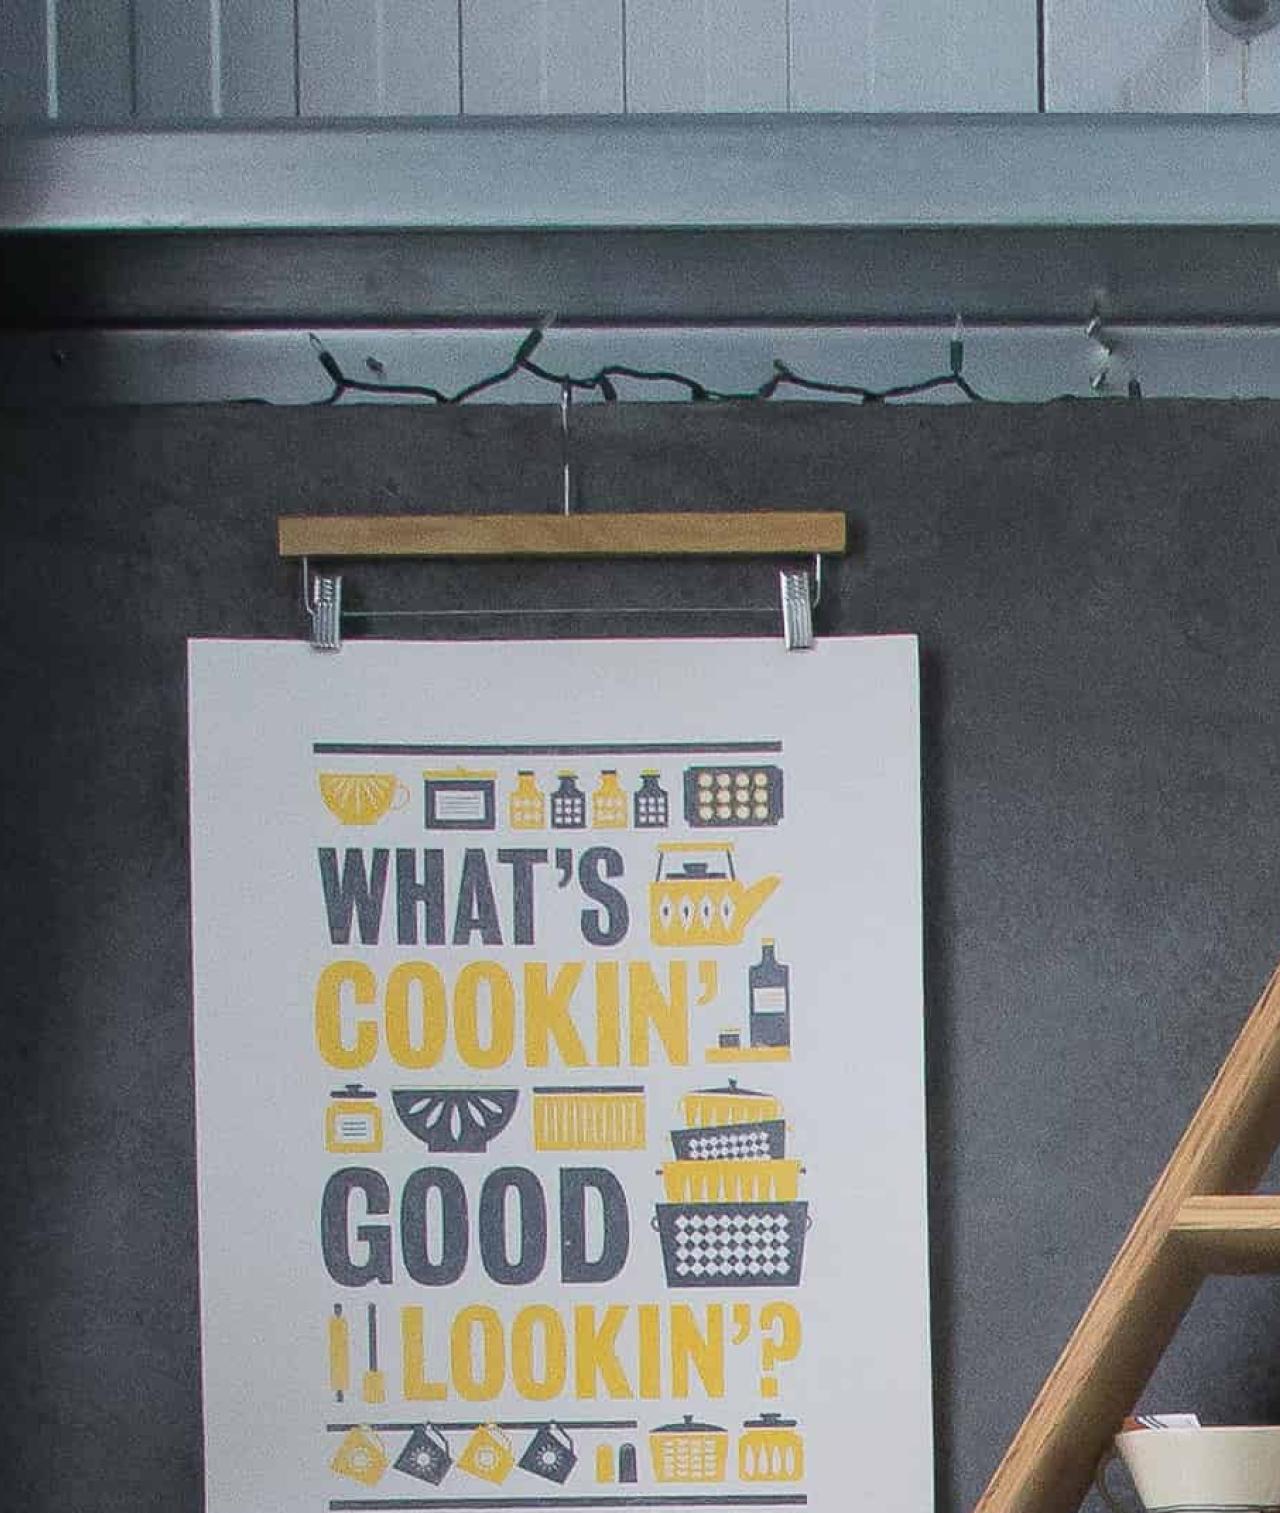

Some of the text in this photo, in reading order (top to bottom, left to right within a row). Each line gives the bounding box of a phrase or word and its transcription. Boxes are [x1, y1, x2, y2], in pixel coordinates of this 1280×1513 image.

[318, 847, 630, 947] WHAT'S
[316, 961, 718, 1070] COOKIN'
[321, 1167, 631, 1289] GOOD
[402, 1303, 803, 1402] LOOKIN'?
